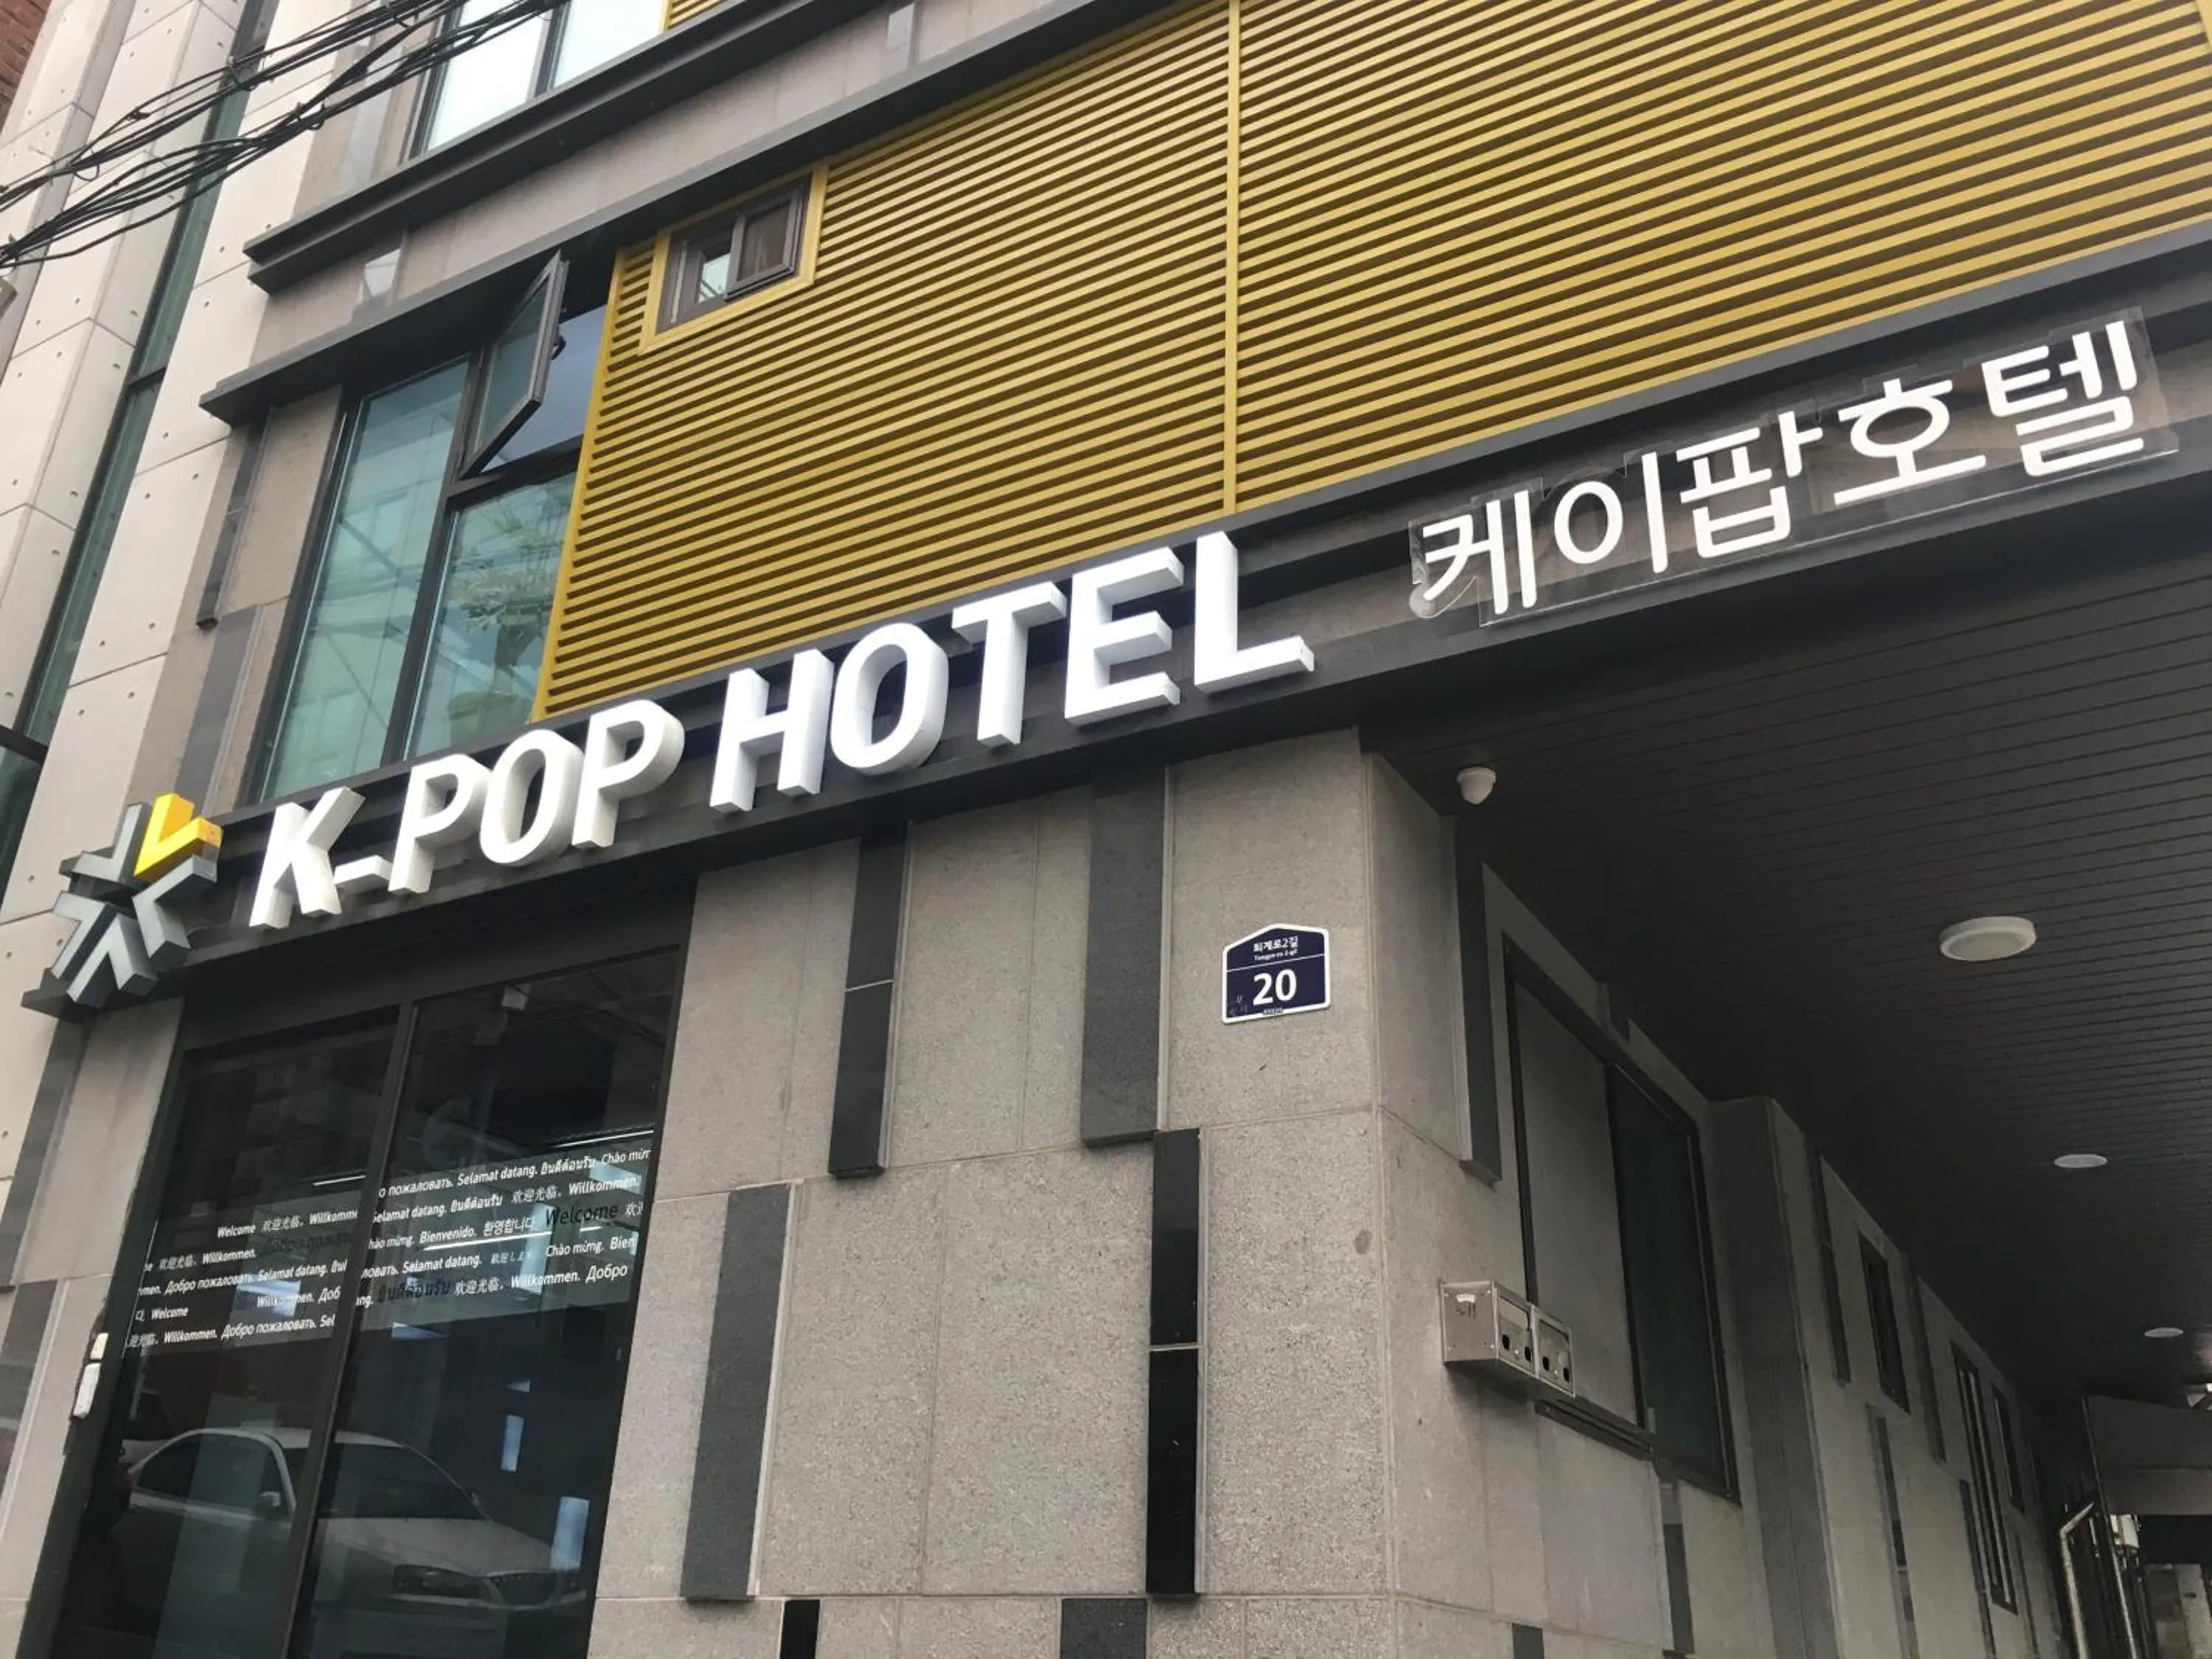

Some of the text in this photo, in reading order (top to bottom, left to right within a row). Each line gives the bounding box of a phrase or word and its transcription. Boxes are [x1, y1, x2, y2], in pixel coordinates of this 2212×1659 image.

[1422, 320, 2144, 615] 케이팝호텔
[249, 530, 1315, 929] K-POP HOTEL
[1253, 969, 1297, 1006] 20
[218, 1224, 256, 1239] Welcome
[457, 1168, 498, 1186] Selamat
[501, 1165, 538, 1180] datang.
[411, 1203, 447, 1218] datang.
[152, 1307, 189, 1320] Welcome
[402, 1257, 443, 1274] Selamat
[445, 1254, 482, 1269] datang.
[610, 1235, 636, 1251] Bien
[164, 1279, 196, 1295] Добро
[258, 1266, 294, 1281] Selamat
[296, 1264, 327, 1278] datang.
[420, 1225, 476, 1244] Bienvenido.
[546, 1204, 619, 1227] Welcome
[164, 1328, 218, 1343] Willkommen.
[220, 1322, 254, 1340] Добро
[319, 1314, 335, 1328] Sel
[511, 1270, 581, 1289] Willkommen.
[585, 1262, 629, 1284] Добро
